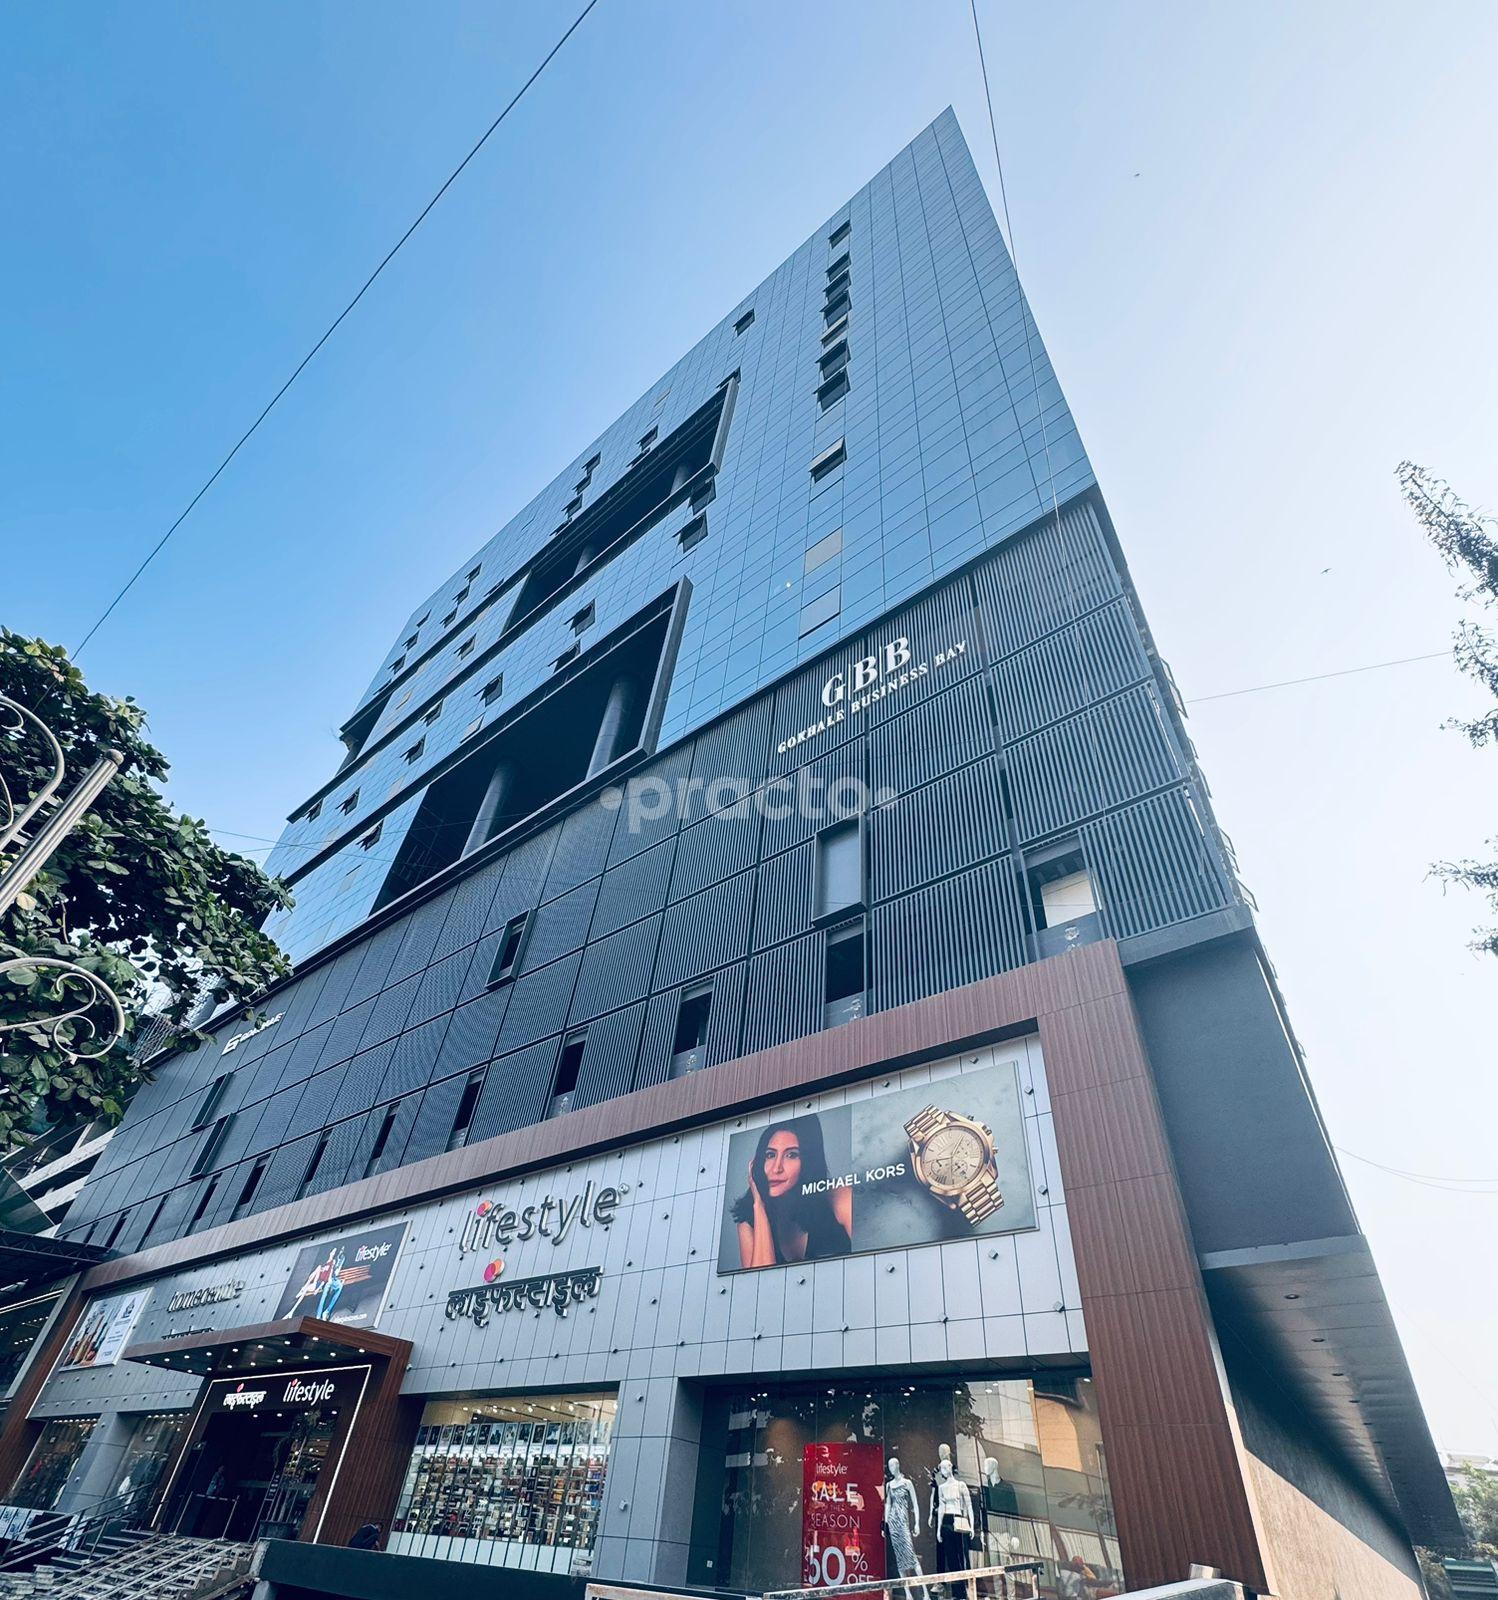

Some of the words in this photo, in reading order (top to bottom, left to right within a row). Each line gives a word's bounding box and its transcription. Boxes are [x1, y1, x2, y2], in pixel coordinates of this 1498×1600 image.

[777, 709, 846, 755] GOKHALE
[850, 662, 929, 715] BUSINESS
[934, 639, 967, 668] BAY
[801, 1173, 861, 1196] MICHAEL
[865, 1163, 906, 1182] KORS
[458, 1180, 621, 1253] lifestyle
[355, 1242, 392, 1262] lifestyle
[282, 1378, 336, 1407] lifestyle
[815, 1462, 848, 1476] lifestyle
[811, 1481, 860, 1503] SALE
[810, 1513, 861, 1529] SEASON
